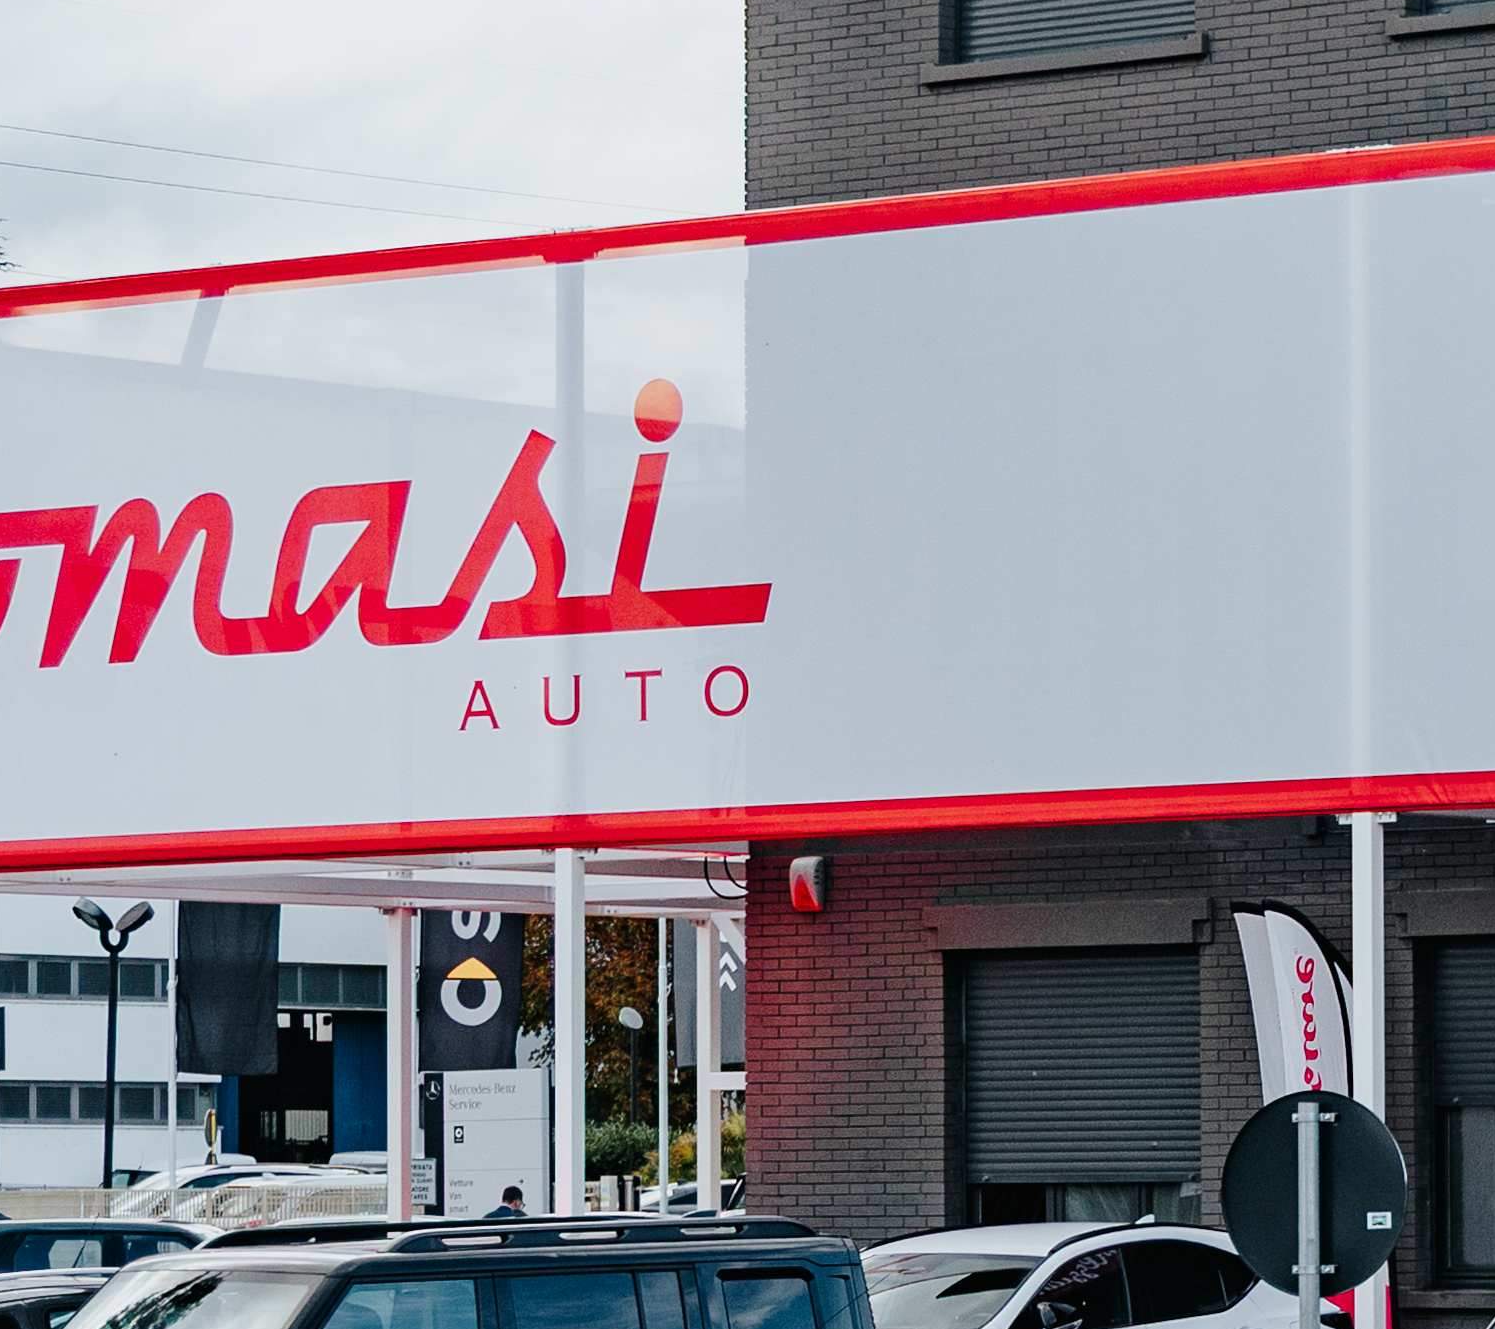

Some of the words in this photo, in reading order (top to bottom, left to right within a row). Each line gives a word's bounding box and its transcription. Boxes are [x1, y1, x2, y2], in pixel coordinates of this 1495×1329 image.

[459, 665, 750, 732] AUTO
[449, 1084, 516, 1096] Mercedes-Benz
[449, 1100, 483, 1111] Service
